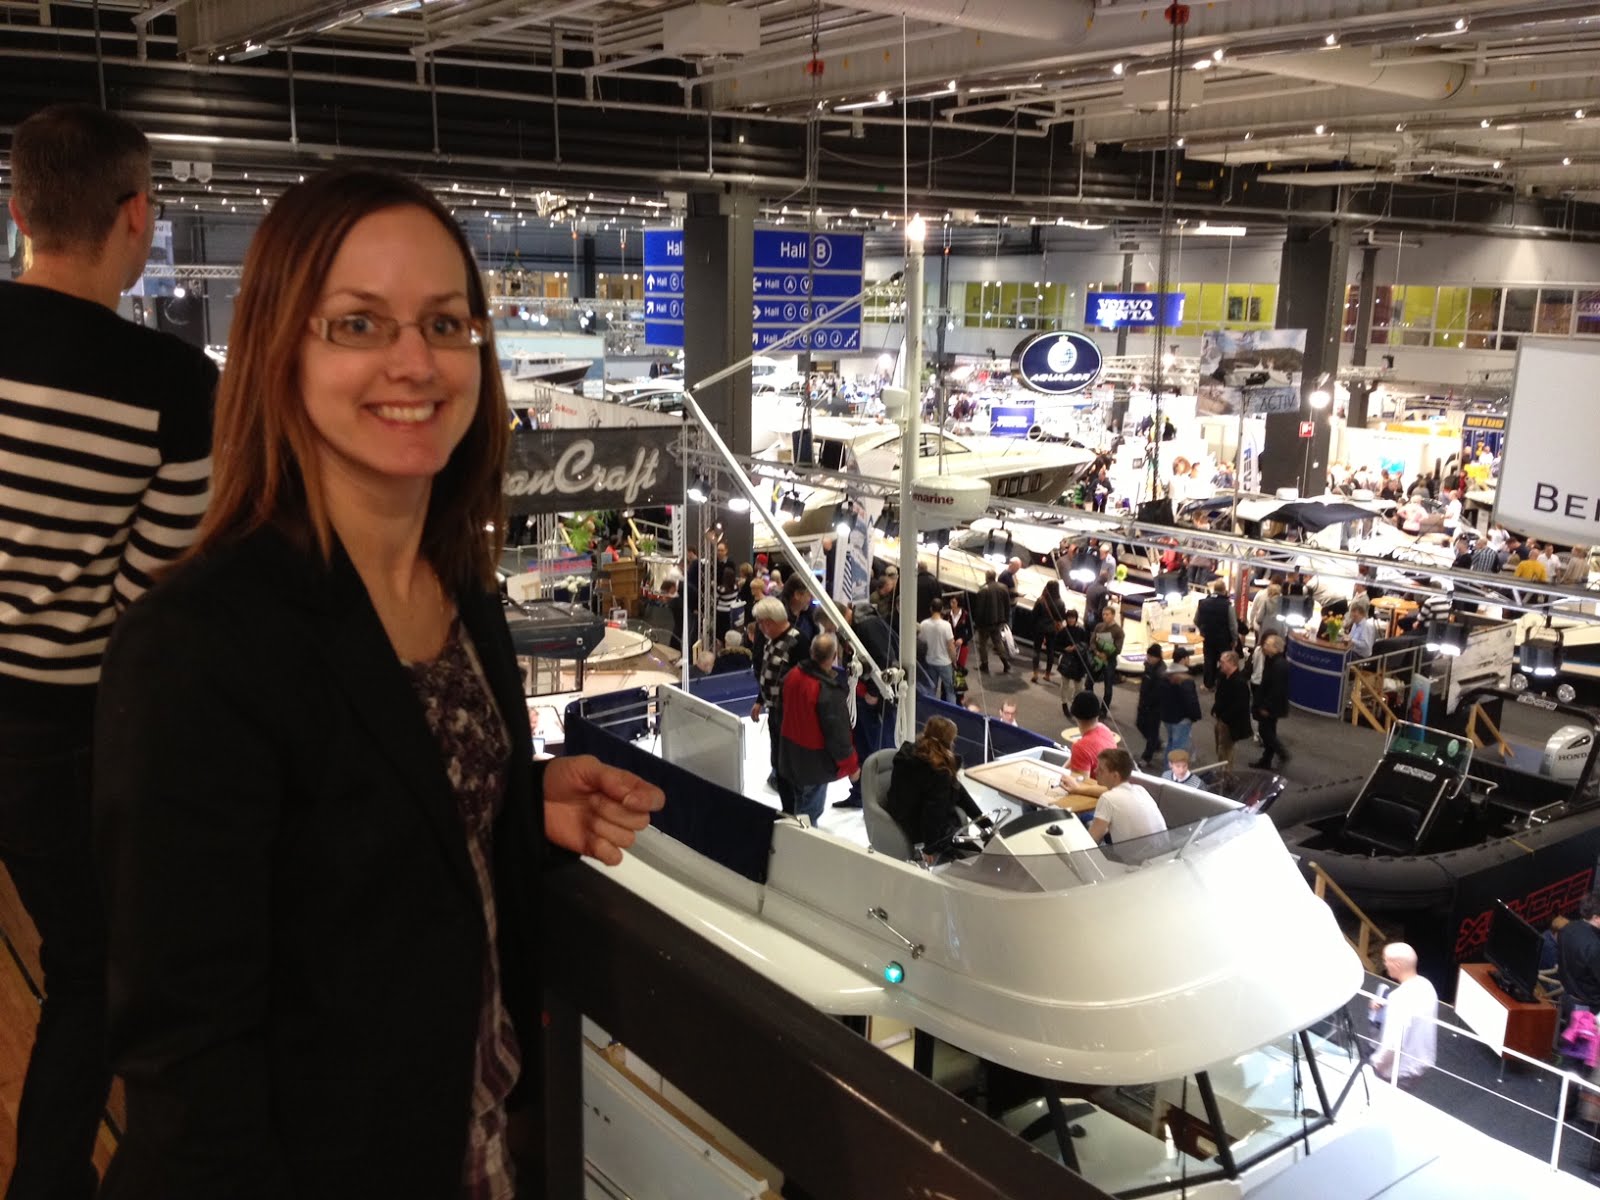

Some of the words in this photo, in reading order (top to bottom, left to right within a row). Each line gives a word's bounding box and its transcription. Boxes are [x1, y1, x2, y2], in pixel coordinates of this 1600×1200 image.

[666, 240, 683, 256] Hal
[780, 241, 806, 259] Hall
[656, 277, 668, 287] Hall
[764, 279, 780, 289] Hall
[656, 303, 667, 314] Hall
[1097, 298, 1153, 311] VOLVO
[764, 306, 780, 317] Hall
[763, 333, 778, 344] Hall
[1029, 372, 1091, 382] AQUADOR
[1533, 482, 1600, 522] BE
[1558, 751, 1588, 761] HOND
